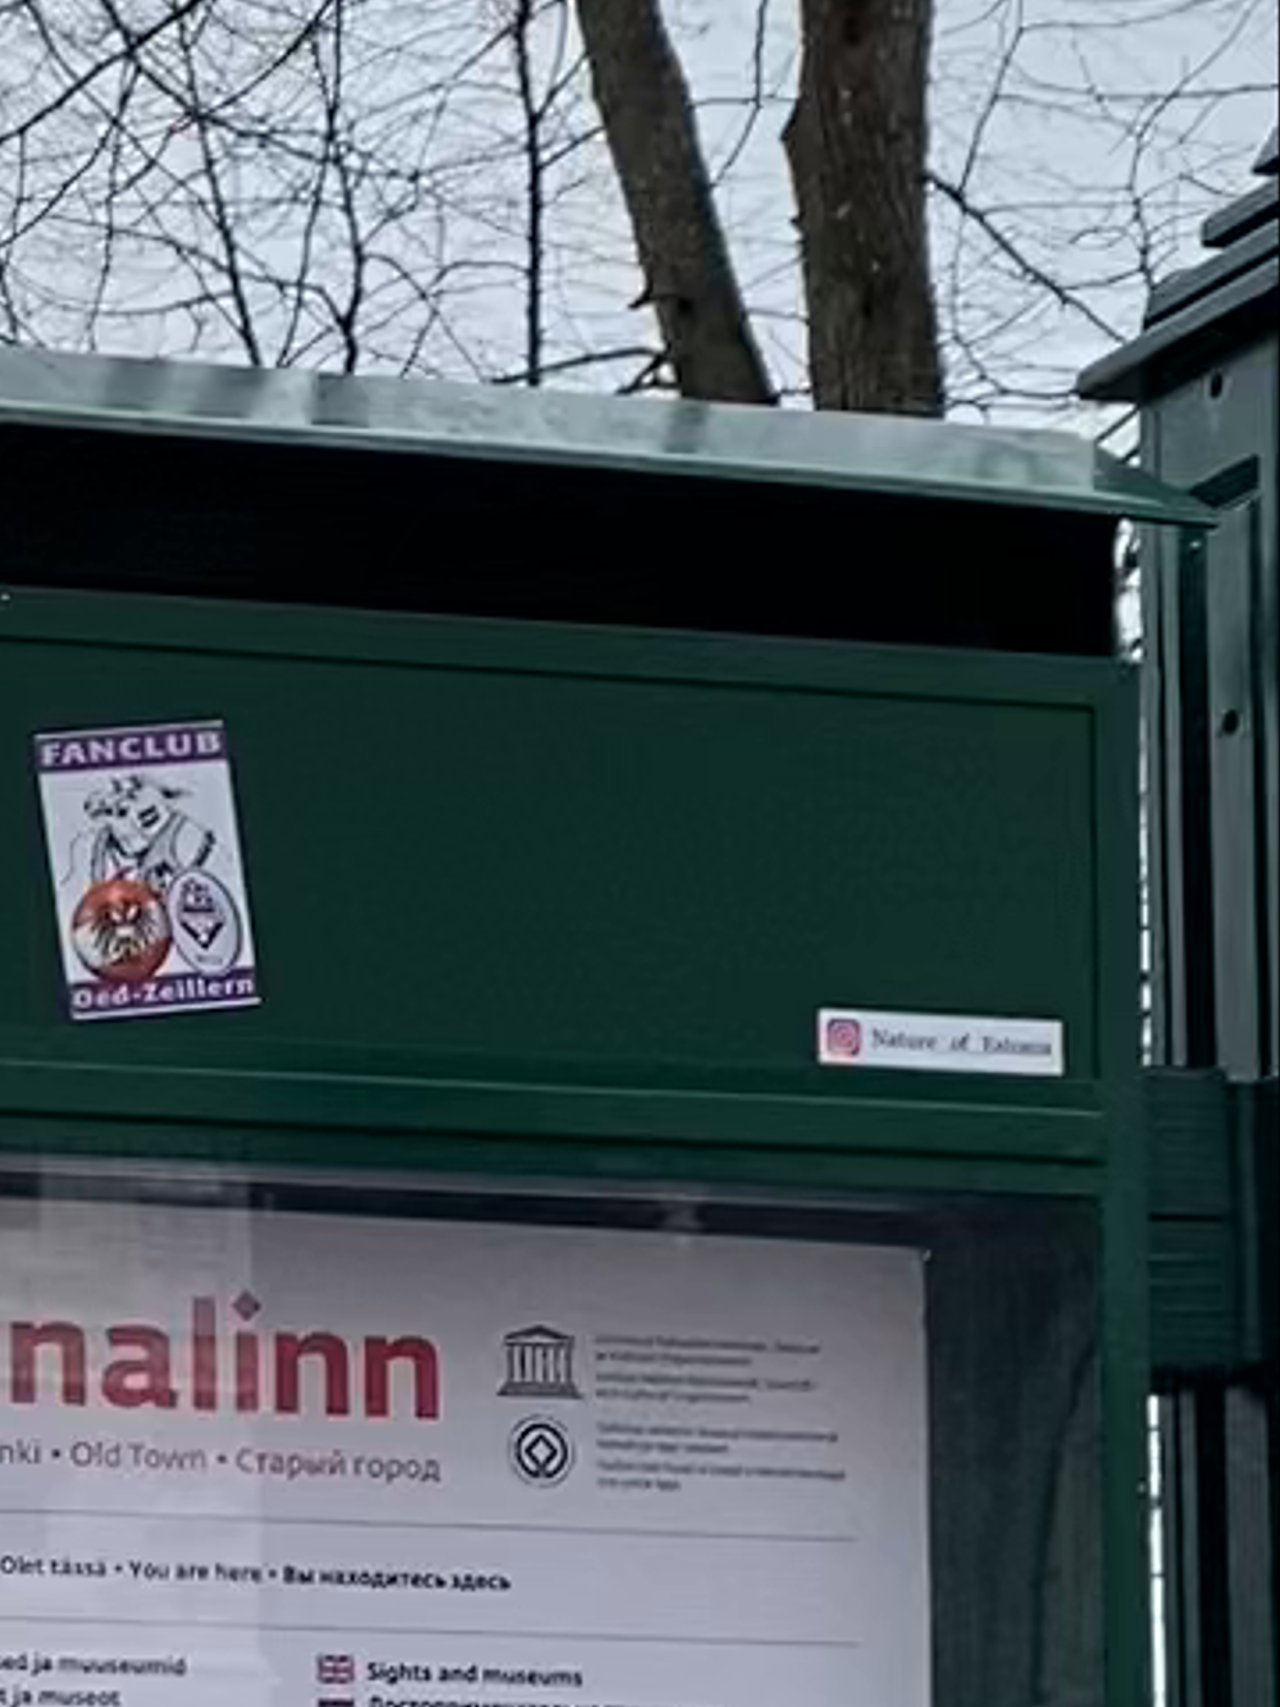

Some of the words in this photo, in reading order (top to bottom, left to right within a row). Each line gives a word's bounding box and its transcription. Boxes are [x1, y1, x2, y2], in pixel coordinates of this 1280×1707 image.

[41, 731, 221, 766] FANCLUB
[70, 1441, 122, 1469] Old
[128, 1441, 207, 1470] Town
[235, 1447, 344, 1479] Старый
[352, 1454, 441, 1484] город
[128, 1558, 171, 1581] You
[174, 1564, 209, 1581] are
[215, 1562, 262, 1583] here
[282, 1565, 315, 1585] Вы
[319, 1568, 447, 1590] находитесь
[452, 1573, 512, 1593] здесь
[31, 1654, 53, 1676] ja
[367, 1661, 431, 1685] Sights
[437, 1664, 477, 1684] and
[482, 1668, 583, 1688] museums
[39, 1689, 121, 1707] museot
